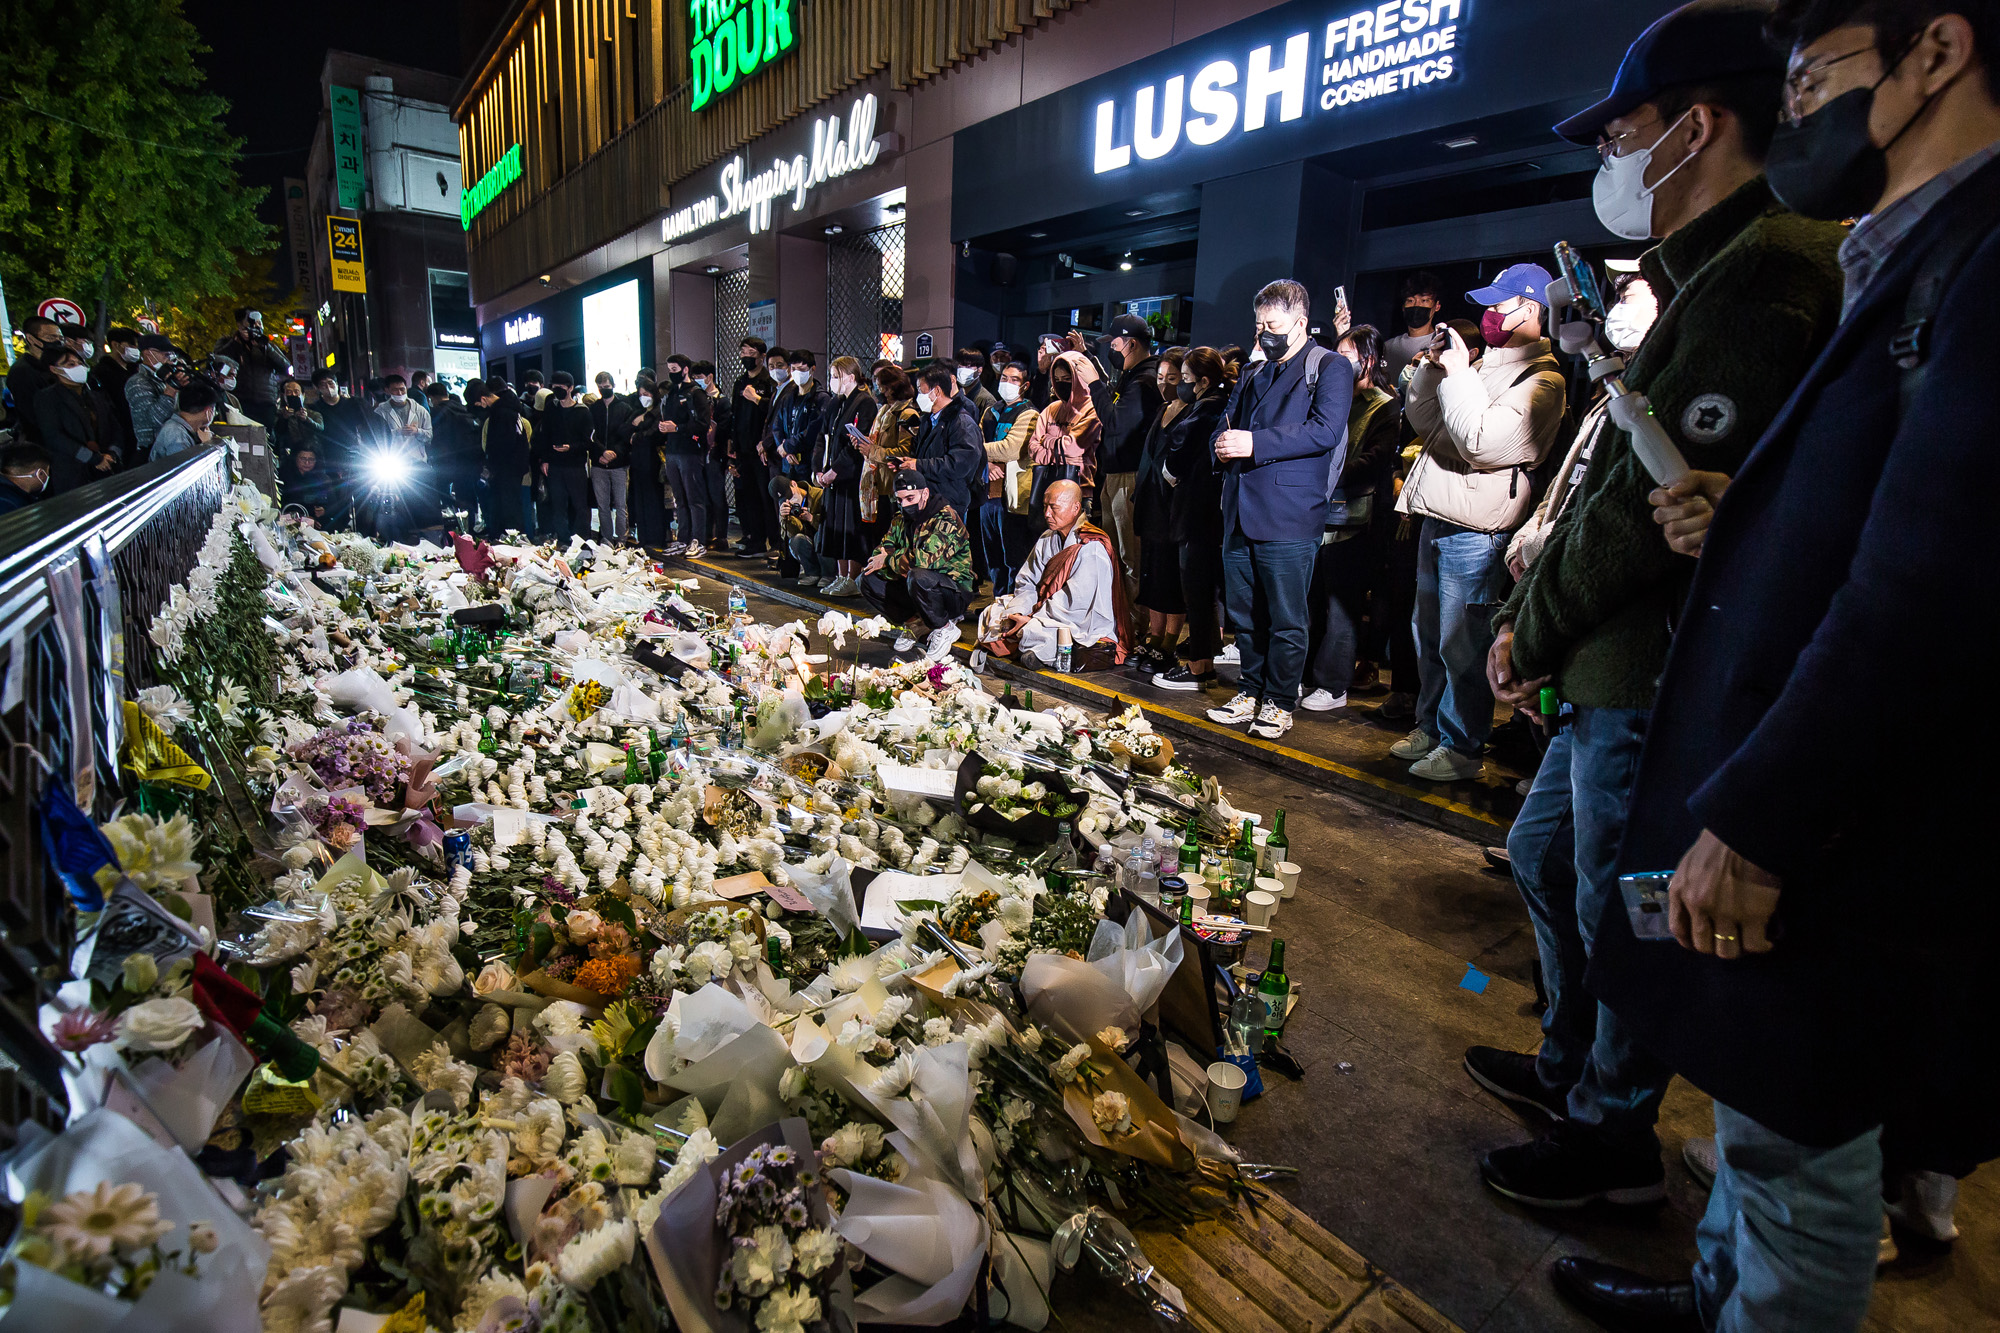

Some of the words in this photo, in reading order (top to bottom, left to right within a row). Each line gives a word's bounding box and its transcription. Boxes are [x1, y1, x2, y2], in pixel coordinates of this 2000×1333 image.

[690, 0, 793, 112] DOUR
[1322, 25, 1457, 86] HANDMADE
[1324, 0, 1461, 59] FRESH
[1094, 32, 1309, 174] LUSH
[1320, 56, 1453, 111] COSMETICS
[339, 131, 360, 174] 치과
[662, 195, 719, 243] HAMILTON
[719, 155, 807, 235] Shopping
[804, 92, 881, 189] Mall
[333, 225, 355, 234] emart
[334, 232, 358, 249] 24
[297, 250, 311, 293] BEACH
[919, 345, 930, 355] 179
